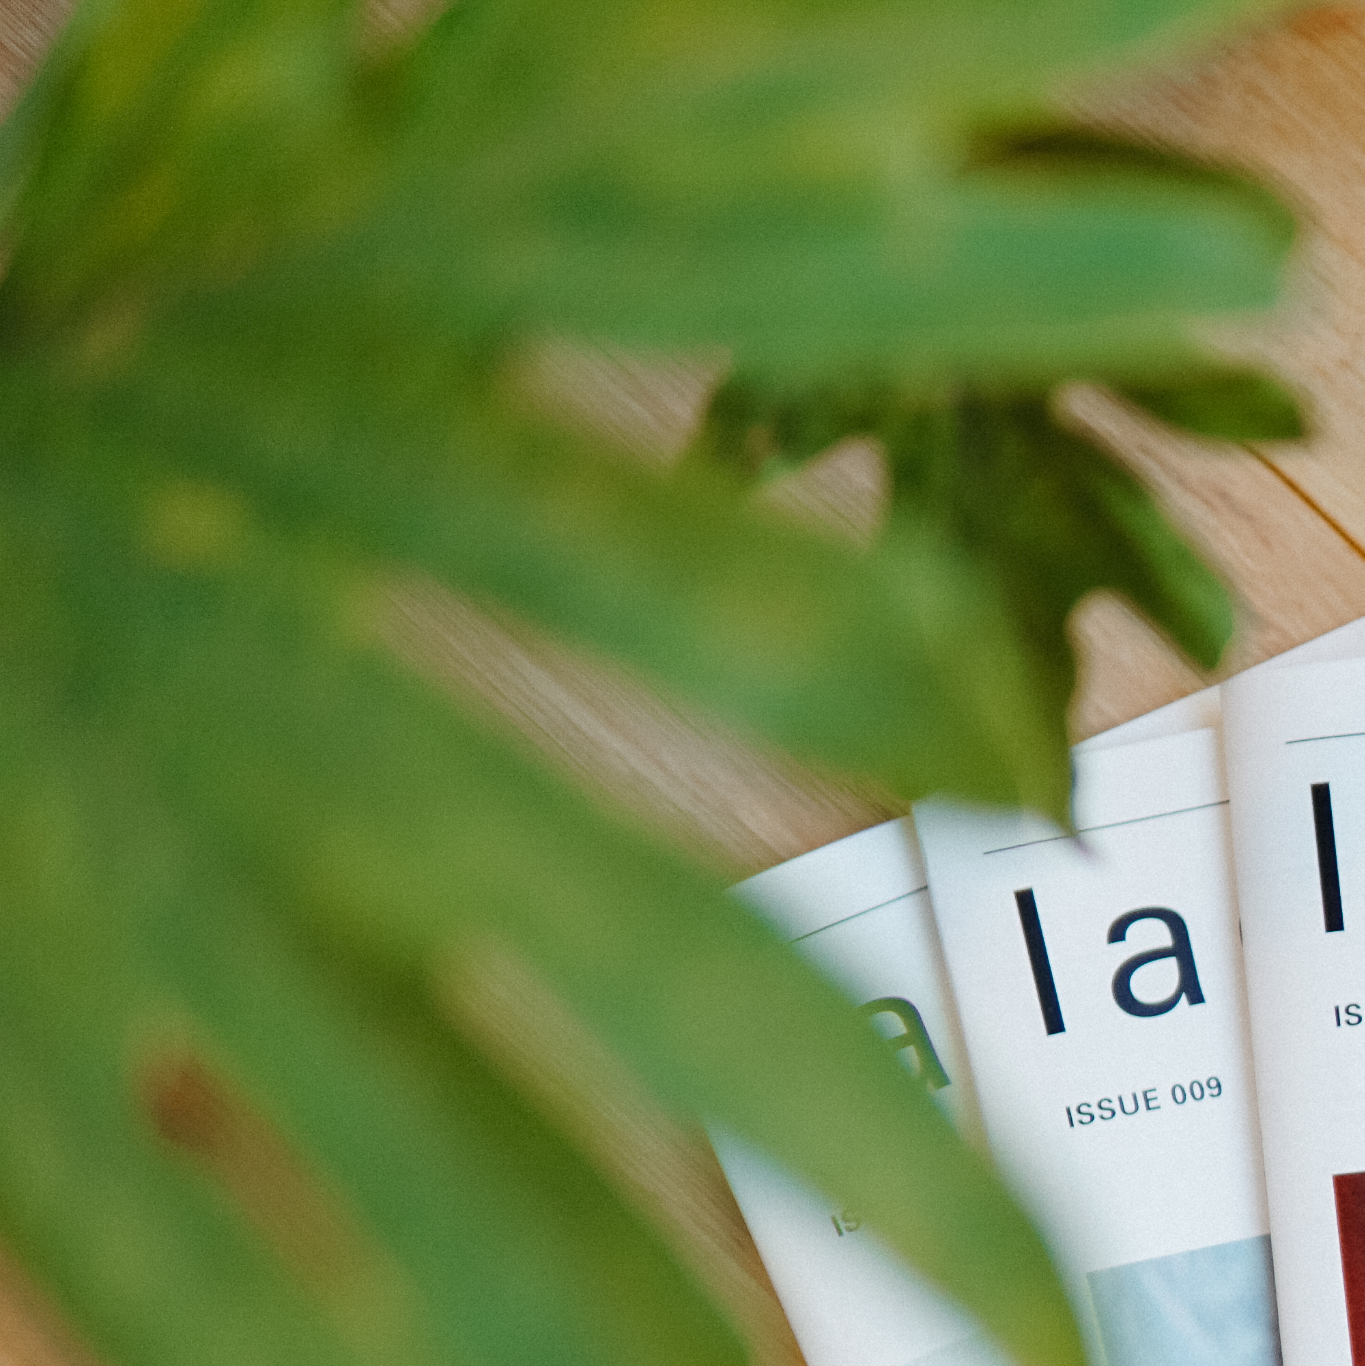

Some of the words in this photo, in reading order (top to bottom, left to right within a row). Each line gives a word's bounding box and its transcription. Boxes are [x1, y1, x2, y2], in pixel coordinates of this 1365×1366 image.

[1014, 887, 1207, 1036] la
[1065, 1088, 1162, 1129] ISSUE
[1171, 1076, 1224, 1106] 009
